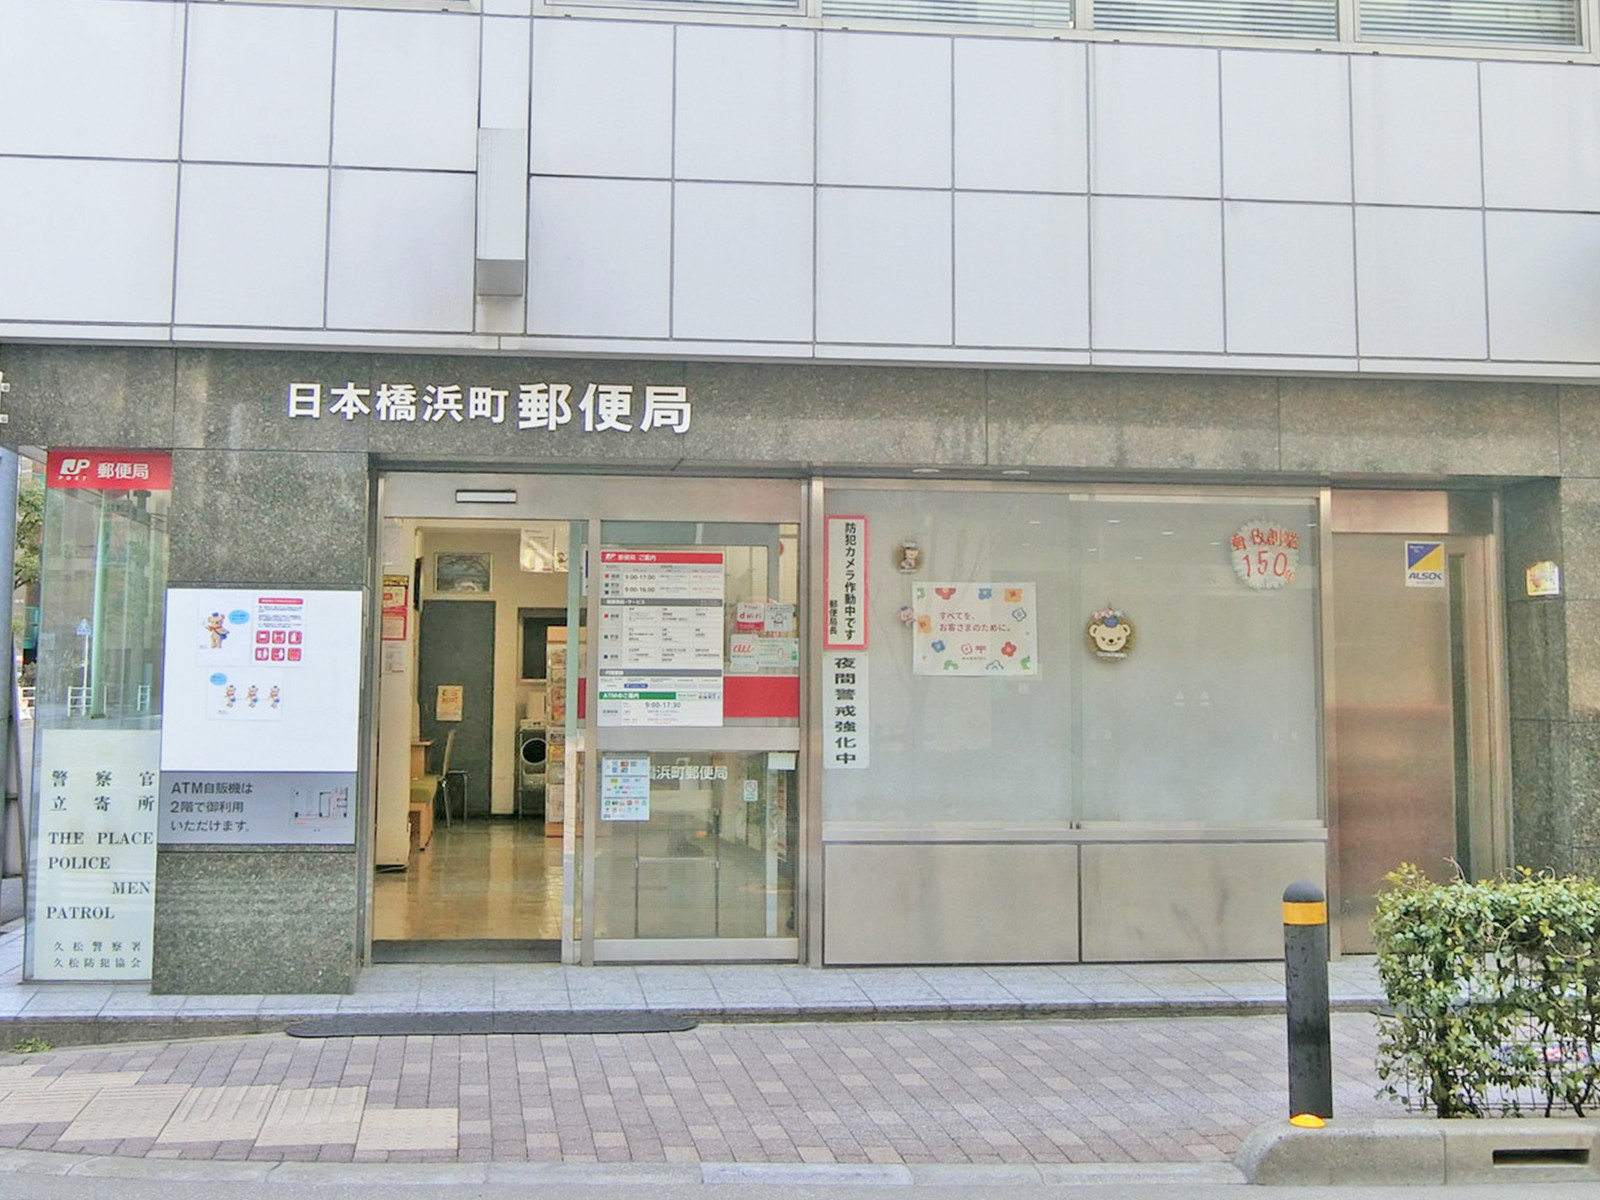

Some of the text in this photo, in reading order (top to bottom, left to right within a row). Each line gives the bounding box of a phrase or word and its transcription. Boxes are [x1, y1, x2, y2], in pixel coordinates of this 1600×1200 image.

[288, 382, 693, 434] 日本橋浜町郵便局
[97, 462, 149, 479] 郵便局
[844, 522, 857, 640] 防犯カメラ作動中です
[1408, 572, 1443, 581] ALSOK
[939, 624, 1011, 632] お客さまのために。
[834, 657, 857, 764] 夜間警戒強化中
[51, 770, 155, 787] 警察官
[171, 781, 253, 795] ATM自販機は
[50, 795, 155, 812] 立寄所
[170, 801, 244, 814] 2階で御利用
[171, 820, 250, 832] いただけます。
[48, 831, 154, 845] THE PLACE
[48, 856, 111, 870] POLICE
[112, 881, 151, 895] MEN
[46, 906, 115, 919] PATROL
[54, 941, 141, 952] 久松警察署
[54, 957, 141, 968] 久松防犯協会
